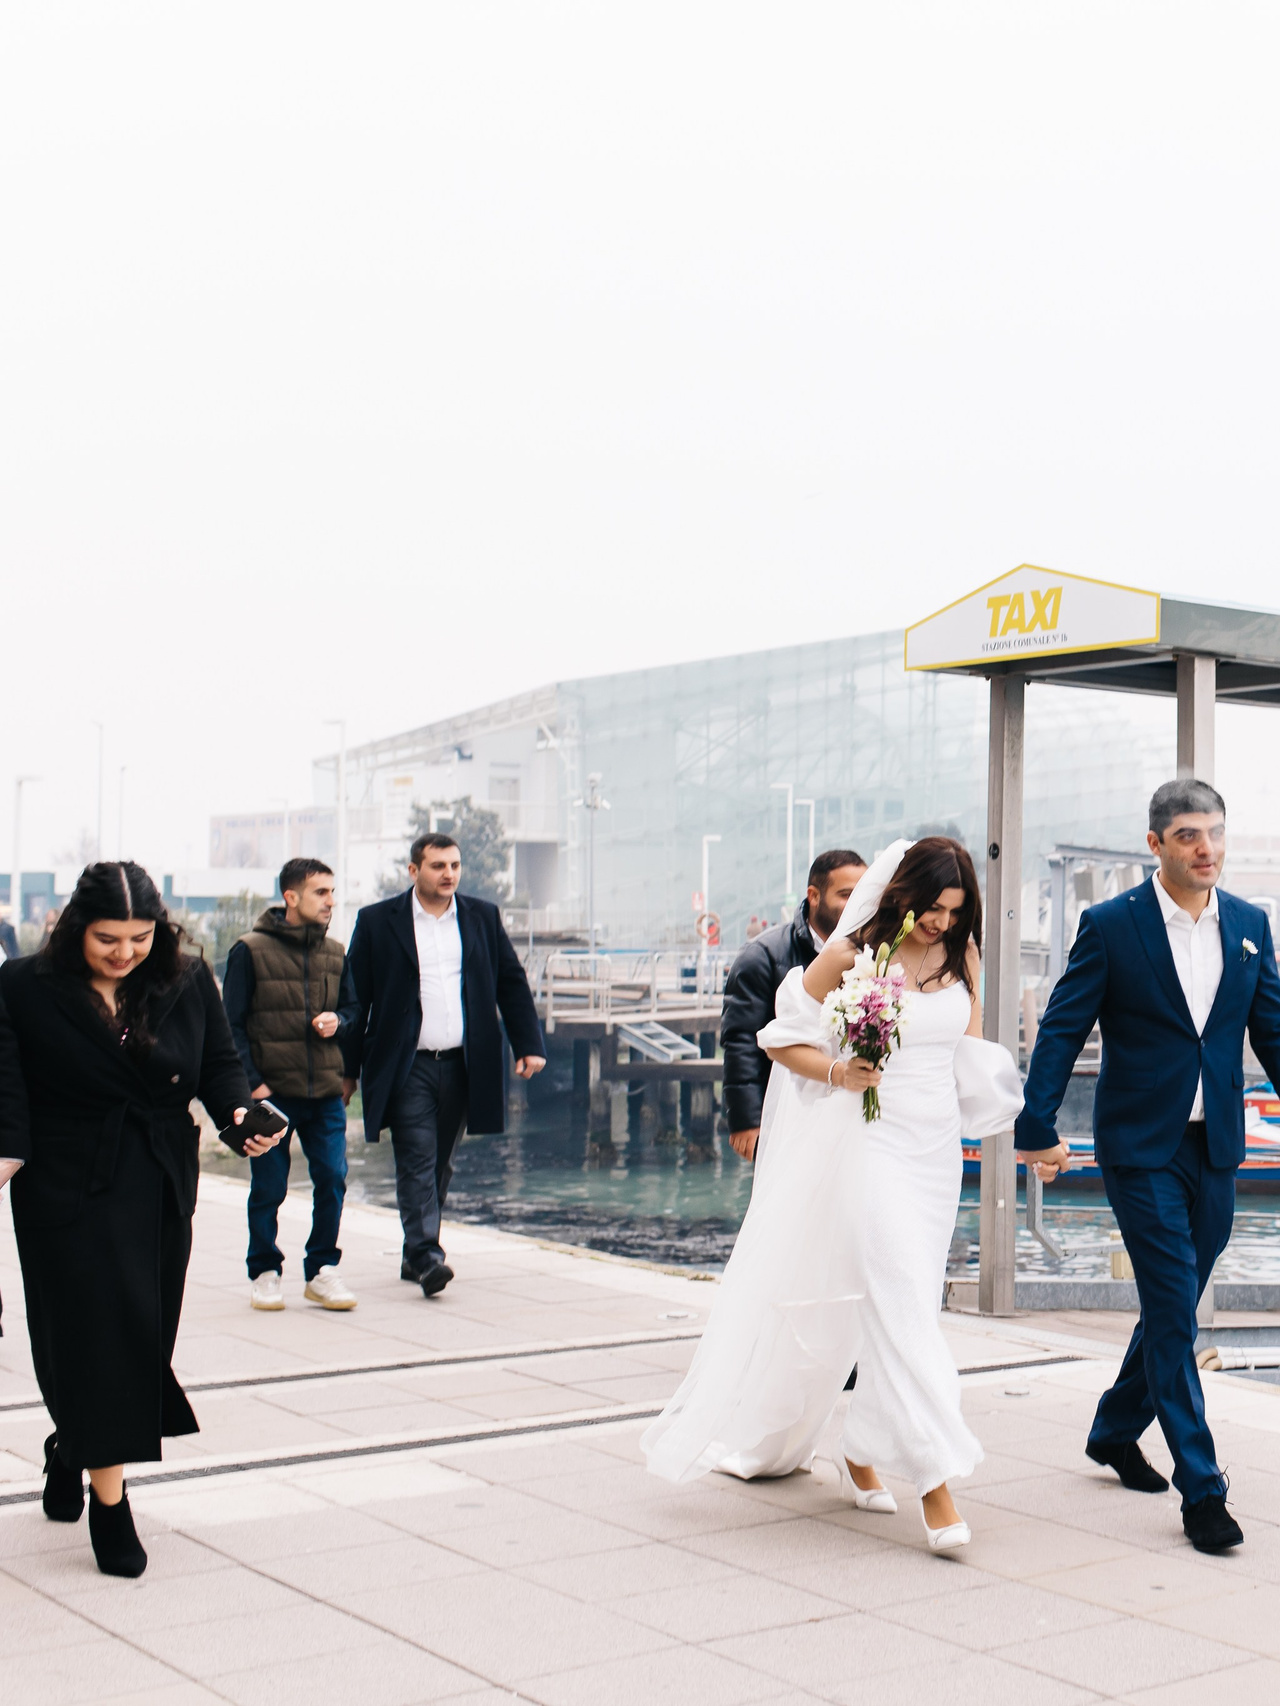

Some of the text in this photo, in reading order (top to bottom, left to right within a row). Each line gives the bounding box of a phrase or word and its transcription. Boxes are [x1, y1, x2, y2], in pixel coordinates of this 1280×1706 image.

[986, 586, 1063, 638] TAXI
[981, 638, 1012, 652] STAZIONE
[1013, 635, 1050, 648] COMUNALE
